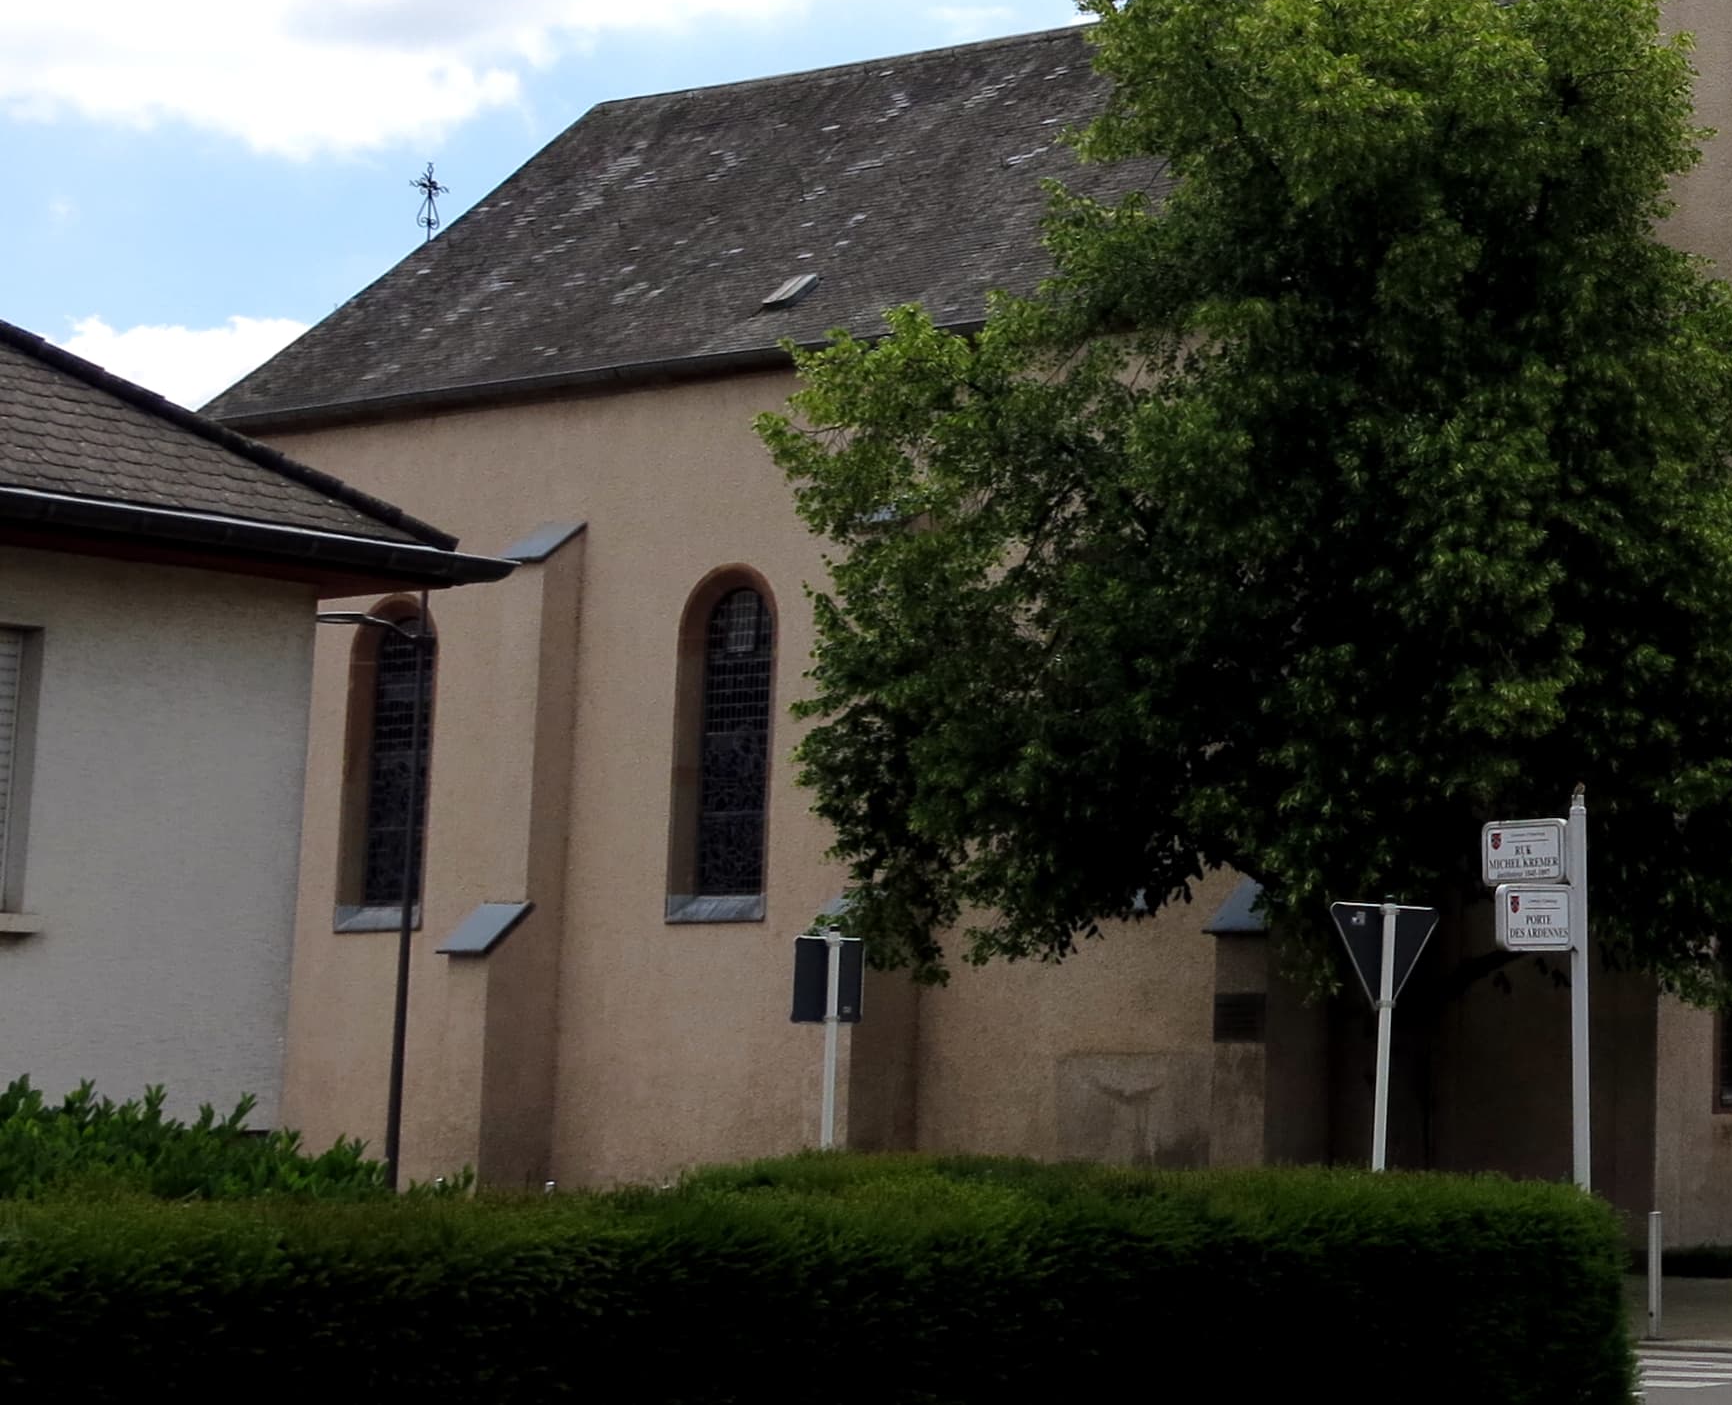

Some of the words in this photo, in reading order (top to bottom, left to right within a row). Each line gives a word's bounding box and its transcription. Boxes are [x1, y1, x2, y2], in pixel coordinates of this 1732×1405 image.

[1514, 845, 1532, 855] RUE
[1489, 858, 1521, 869] MICHEL
[1523, 856, 1559, 868] KREMER
[1526, 914, 1552, 924] PORTE
[1510, 928, 1525, 938] DES
[1527, 927, 1569, 938] ARDENNES
